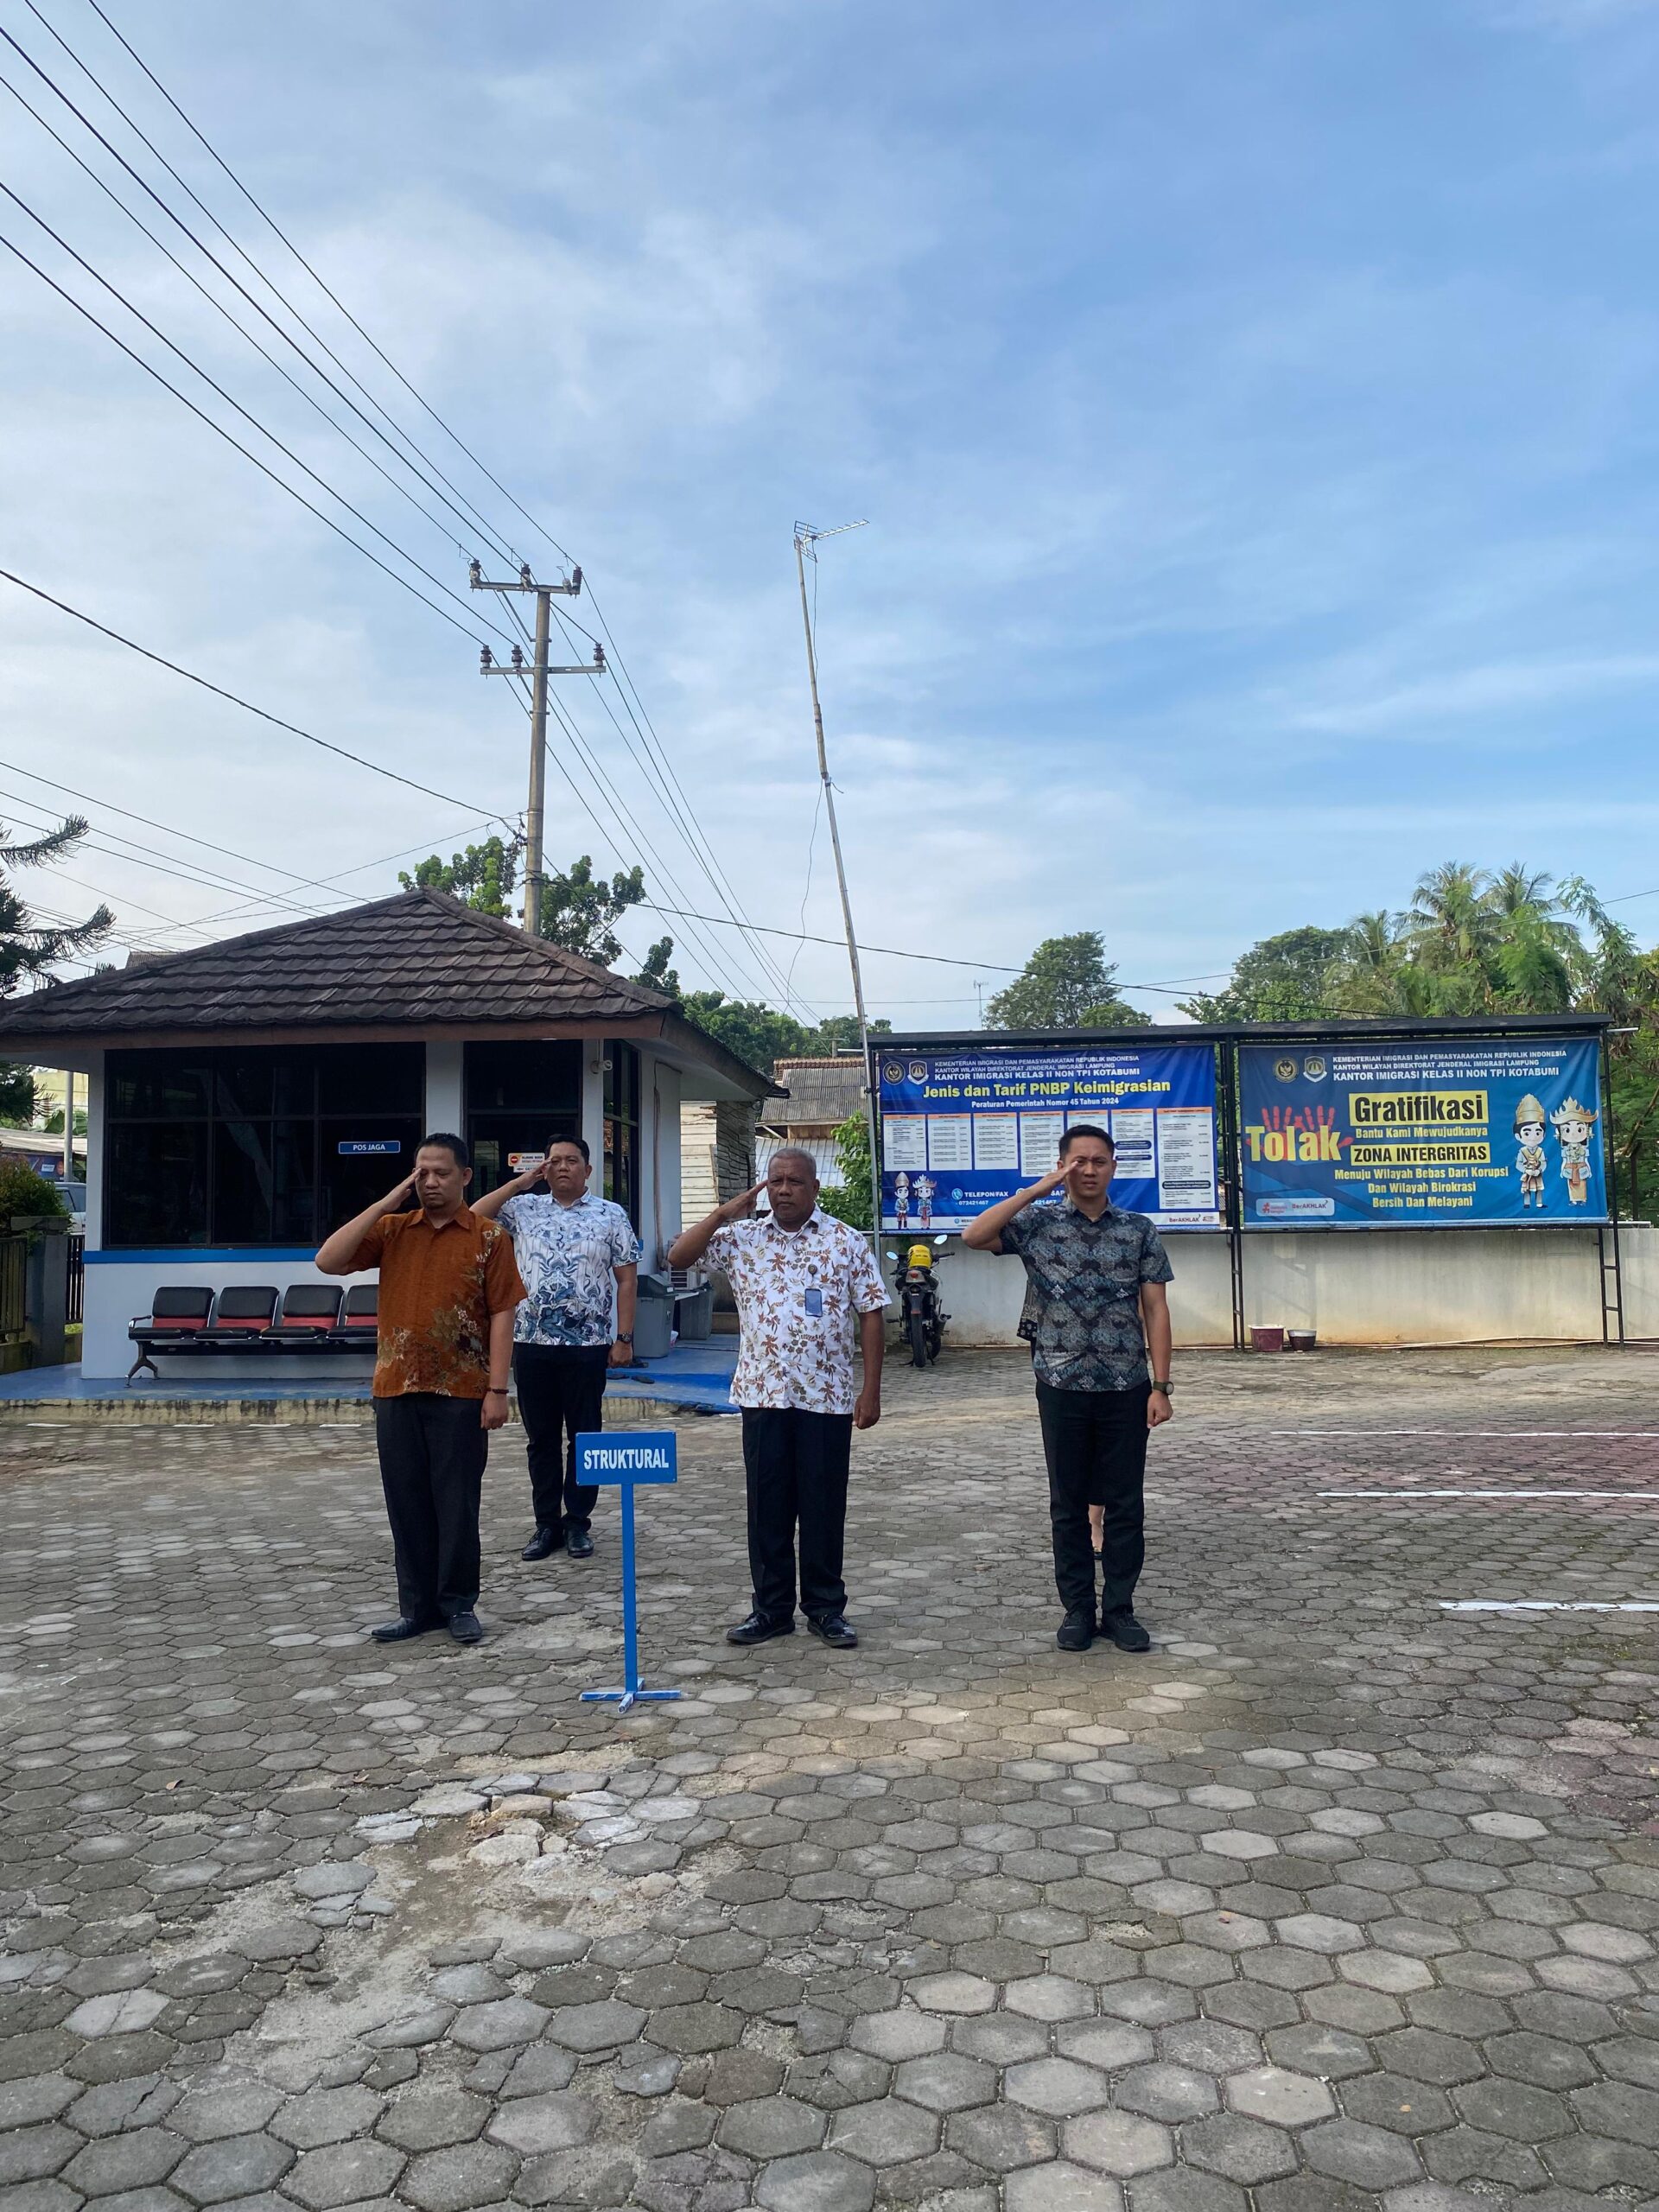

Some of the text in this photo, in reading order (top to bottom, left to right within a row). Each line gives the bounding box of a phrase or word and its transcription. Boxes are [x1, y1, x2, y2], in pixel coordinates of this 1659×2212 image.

[1014, 1071, 1044, 1079] KELAS
[1333, 1066, 1560, 1081] KANTOR IMIGRASI KELAS II NON TPI KOTABUMI
[923, 1079, 1171, 1098] Jenis dan Tarif PNBP Keimigrasian
[1355, 1094, 1484, 1122] Gratifikasi
[1355, 1126, 1488, 1139] Bantu Kami Mewujudkanya
[1244, 1125, 1342, 1162] Tolak
[1354, 1146, 1487, 1162] ZONA INTERGRITAS
[1334, 1166, 1509, 1180] Menuju Wilayah Bebas Dari Korupsi
[1368, 1181, 1476, 1194] Dan Wilayah Birokrasi
[1372, 1196, 1473, 1208] Bersih Dan Melayani
[583, 1448, 670, 1469] STRUKTURAL
